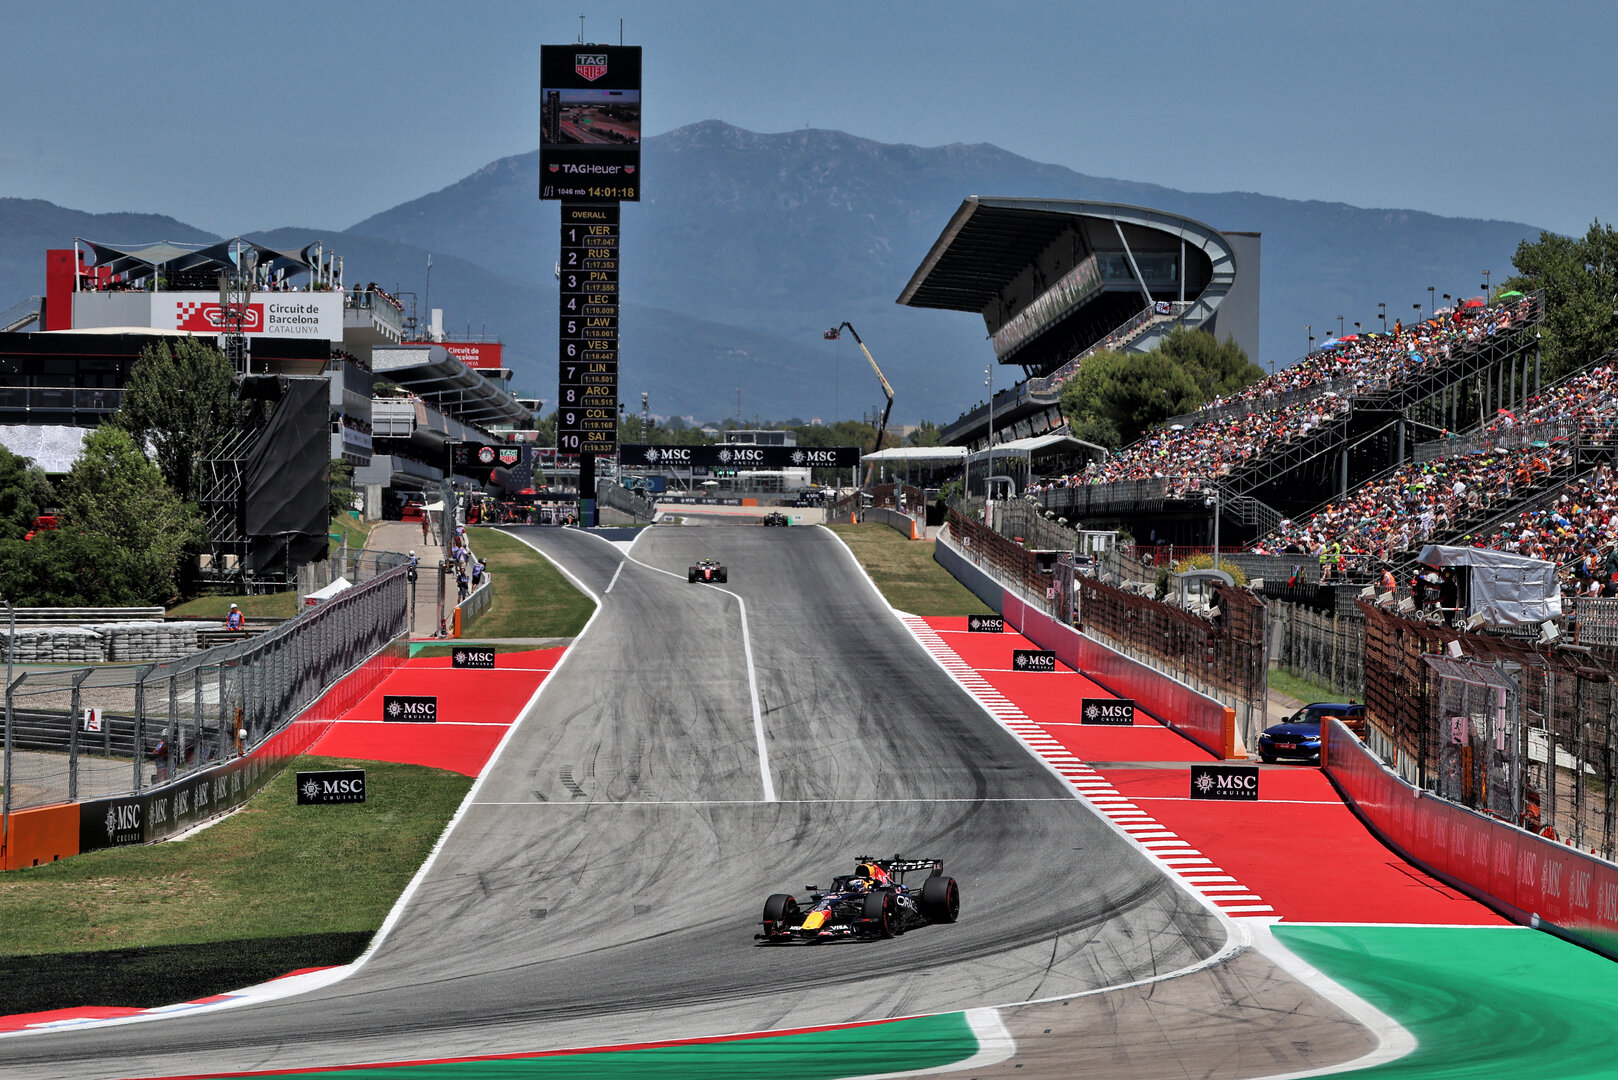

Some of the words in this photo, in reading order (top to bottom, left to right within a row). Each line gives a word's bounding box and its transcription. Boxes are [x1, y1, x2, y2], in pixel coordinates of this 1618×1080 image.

[578, 56, 604, 64] TAG
[577, 66, 606, 79] HEUER
[588, 187, 634, 197] 14:01:18
[569, 229, 575, 242] 1
[589, 226, 610, 234] VER
[568, 252, 577, 264] 2
[588, 249, 610, 258] RUS
[568, 275, 576, 287] 3
[590, 272, 608, 280] PIA
[270, 304, 305, 314] Circuit
[307, 304, 318, 314] de
[568, 298, 576, 310] 4
[588, 295, 609, 303] LEC
[269, 314, 319, 324] Barcelona
[568, 321, 576, 333] 5
[587, 318, 610, 326] LAW
[268, 325, 319, 334] CATALUNYA
[567, 344, 576, 356] 6
[588, 341, 608, 349] VES
[567, 367, 576, 379] 7
[590, 364, 606, 372] LIN
[567, 390, 575, 402] 8
[586, 386, 609, 395] ARO
[566, 413, 575, 424] 9
[586, 410, 608, 418] COL
[562, 435, 578, 448] 10
[588, 432, 606, 440] SAI
[660, 449, 690, 459] MSC
[733, 450, 764, 460] MSC
[807, 451, 836, 461] MSC
[468, 652, 493, 661] MSC
[1029, 656, 1054, 665] MSC
[404, 702, 435, 714] MSC
[1102, 706, 1132, 717] MSC
[323, 779, 363, 794] MSC
[1217, 774, 1256, 789] MSC
[117, 804, 140, 830] MSC
[155, 798, 167, 824] MSC
[117, 833, 140, 842] CRUISES
[1547, 860, 1562, 898] MSC
[1575, 870, 1590, 909] MSC
